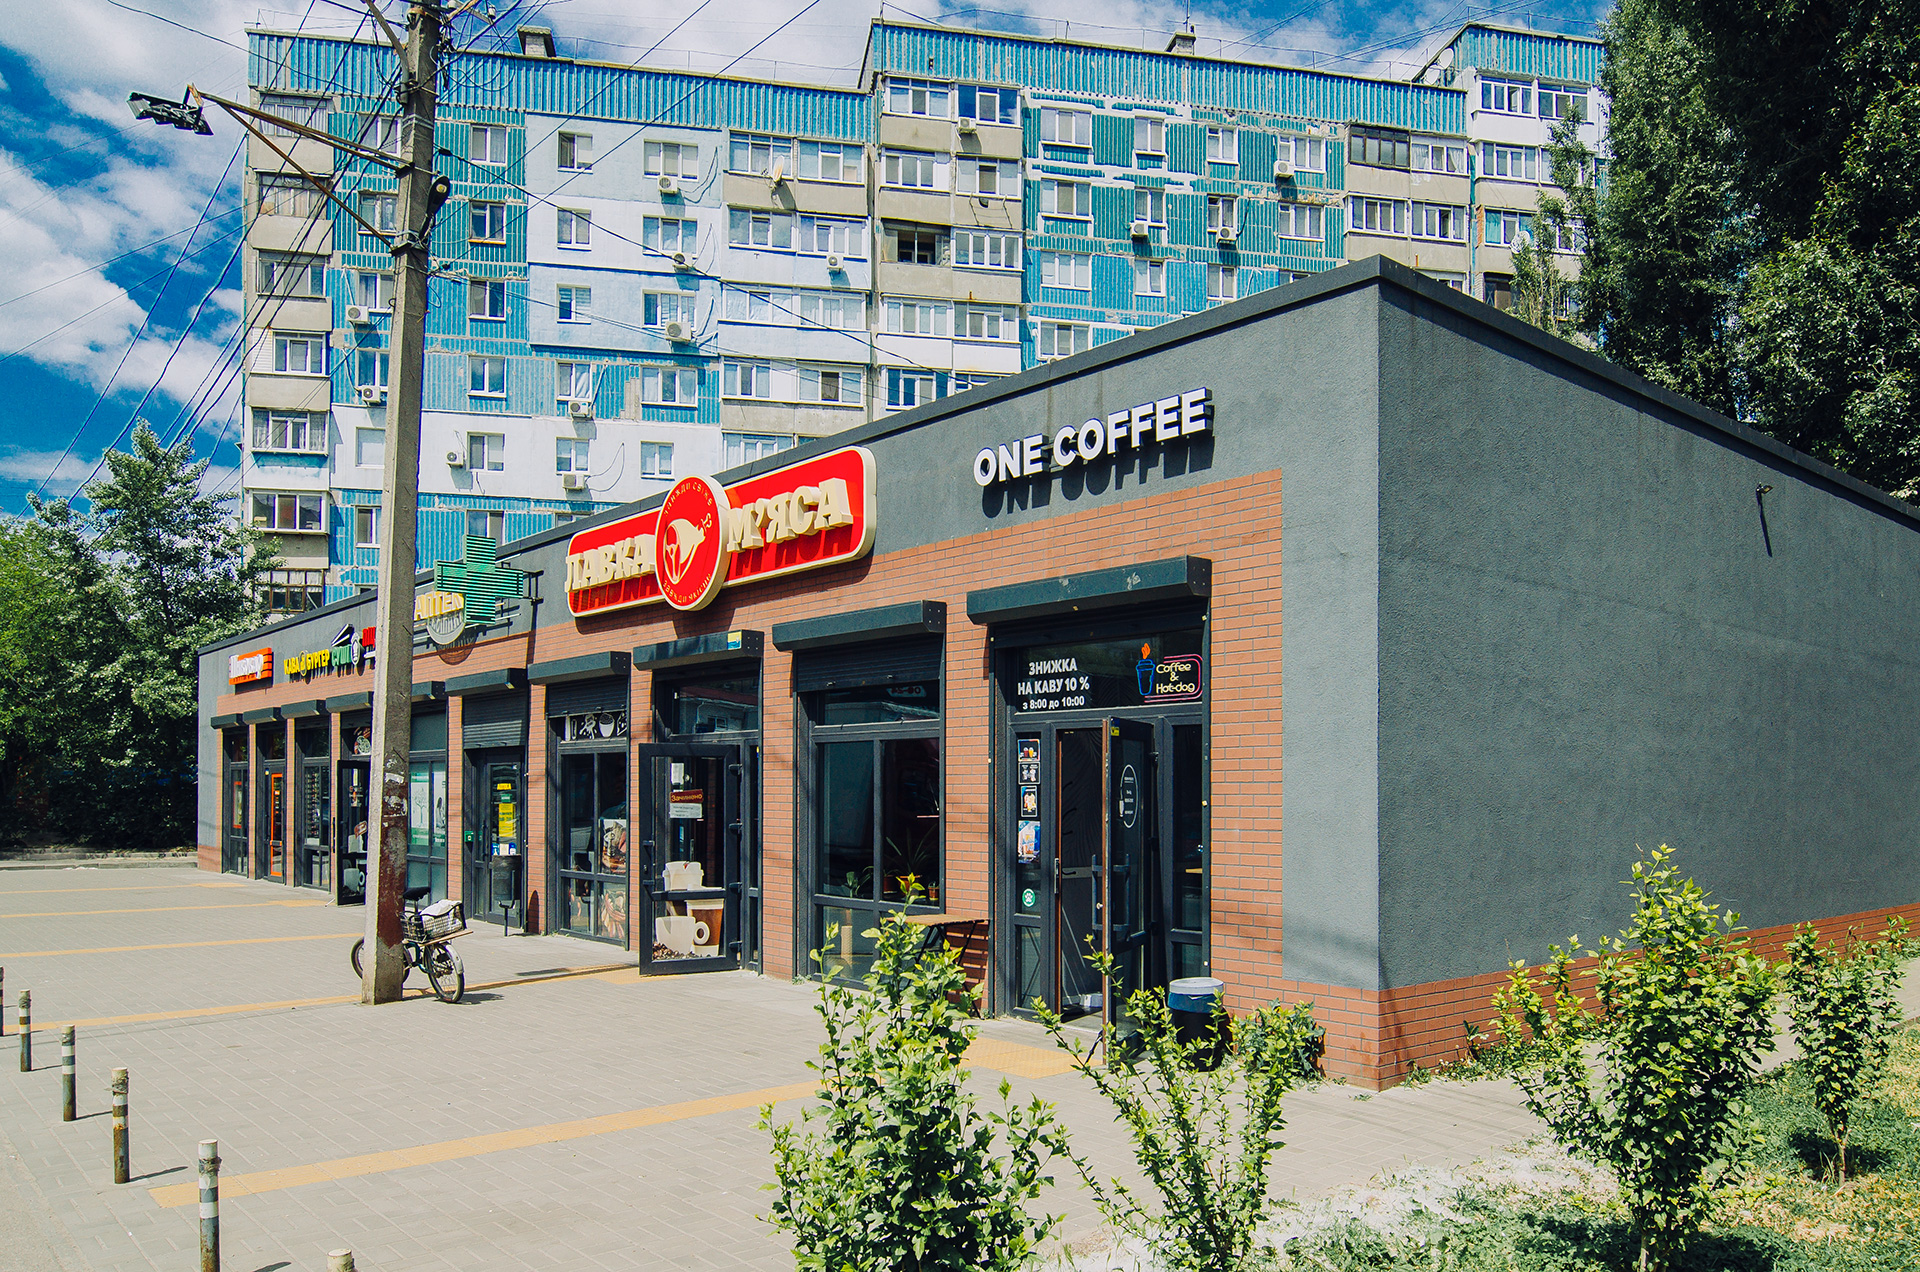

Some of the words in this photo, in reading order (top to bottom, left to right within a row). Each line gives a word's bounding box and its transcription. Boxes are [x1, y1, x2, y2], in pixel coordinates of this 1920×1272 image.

[973, 433, 1046, 487] ONE
[1053, 387, 1210, 467] COFFEE
[564, 533, 656, 593] ЛАВКА
[727, 478, 854, 553] М'ЯСА
[413, 591, 464, 622] АПТЕК
[283, 657, 301, 675] КАВА
[306, 649, 330, 670] БУРГЕР
[1028, 657, 1078, 676] ЗНИЖКА
[1155, 661, 1192, 674] Coffee
[1017, 681, 1033, 696] НА
[1034, 678, 1064, 695] КАВУ
[1064, 677, 1078, 692] 10
[1079, 676, 1090, 690] %
[1169, 671, 1180, 682] &
[1155, 681, 1196, 694] Hot-dog
[1029, 698, 1047, 709] 8:00
[1048, 700, 1060, 710] до
[1061, 695, 1085, 707] 10:00
